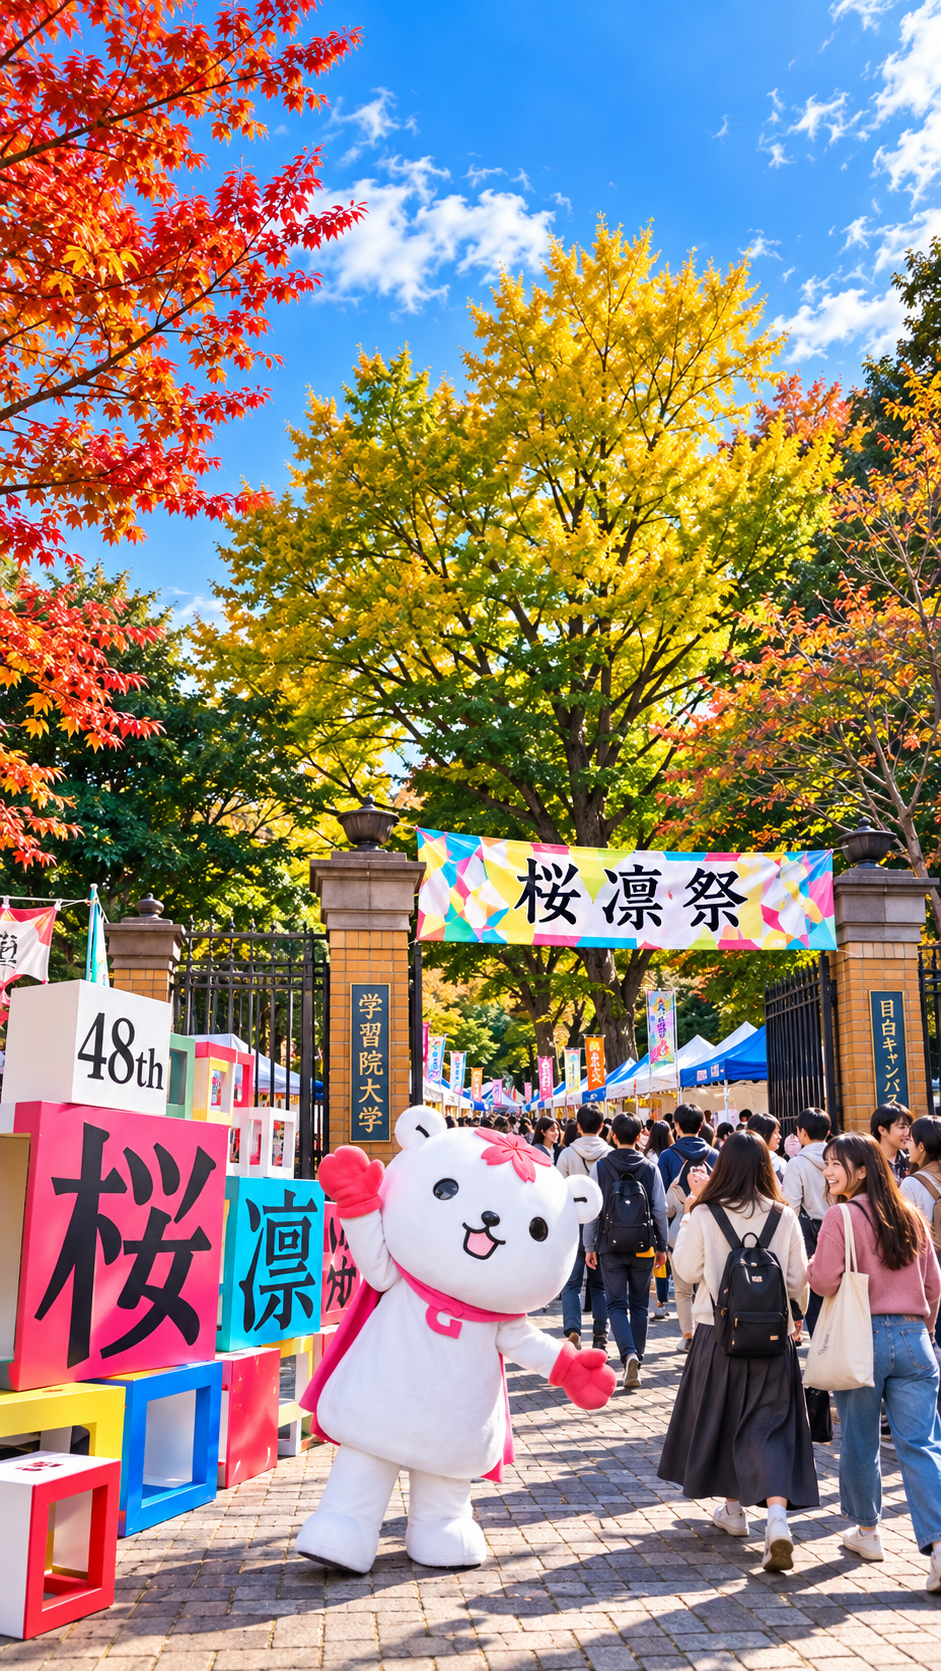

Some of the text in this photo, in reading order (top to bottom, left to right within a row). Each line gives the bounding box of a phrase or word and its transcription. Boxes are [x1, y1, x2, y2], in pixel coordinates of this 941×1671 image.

[515, 858, 748, 932] 桜凛祭
[78, 1012, 164, 1090] 48th
[358, 993, 384, 1133] 学習院大学
[35, 1122, 217, 1369] 桜
[239, 1188, 318, 1333] 凛
